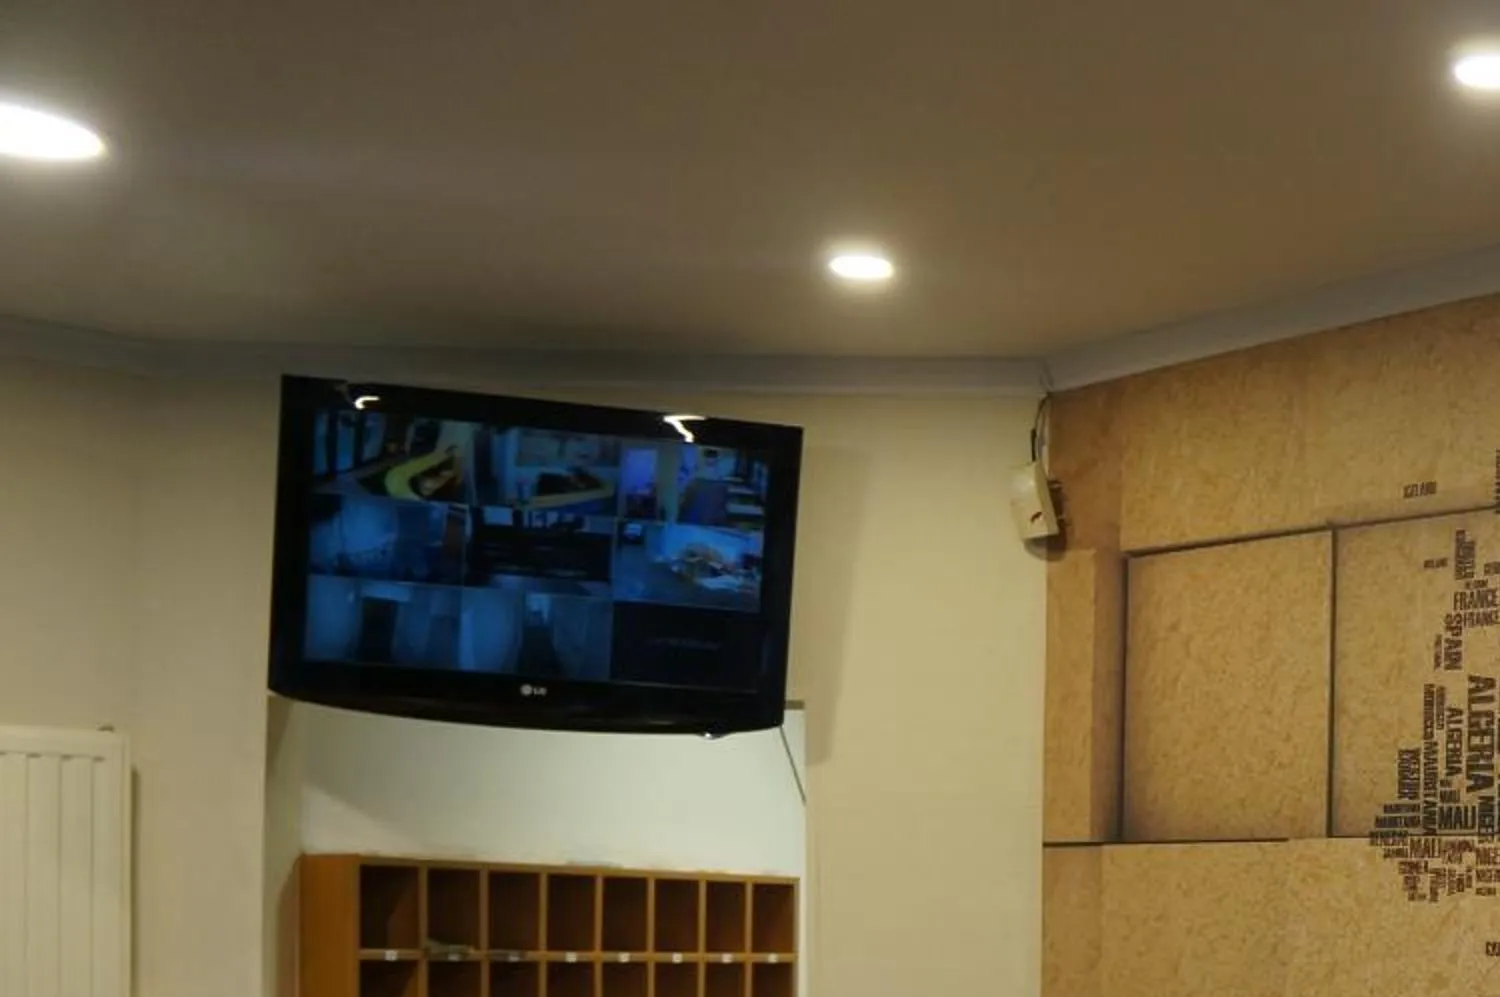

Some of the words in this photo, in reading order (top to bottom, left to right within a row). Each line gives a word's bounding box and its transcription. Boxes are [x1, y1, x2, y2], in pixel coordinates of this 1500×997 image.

[1446, 706, 1464, 776] ALGERIA
[1465, 674, 1497, 793] ALGERIA
[1437, 803, 1478, 831] MALI
